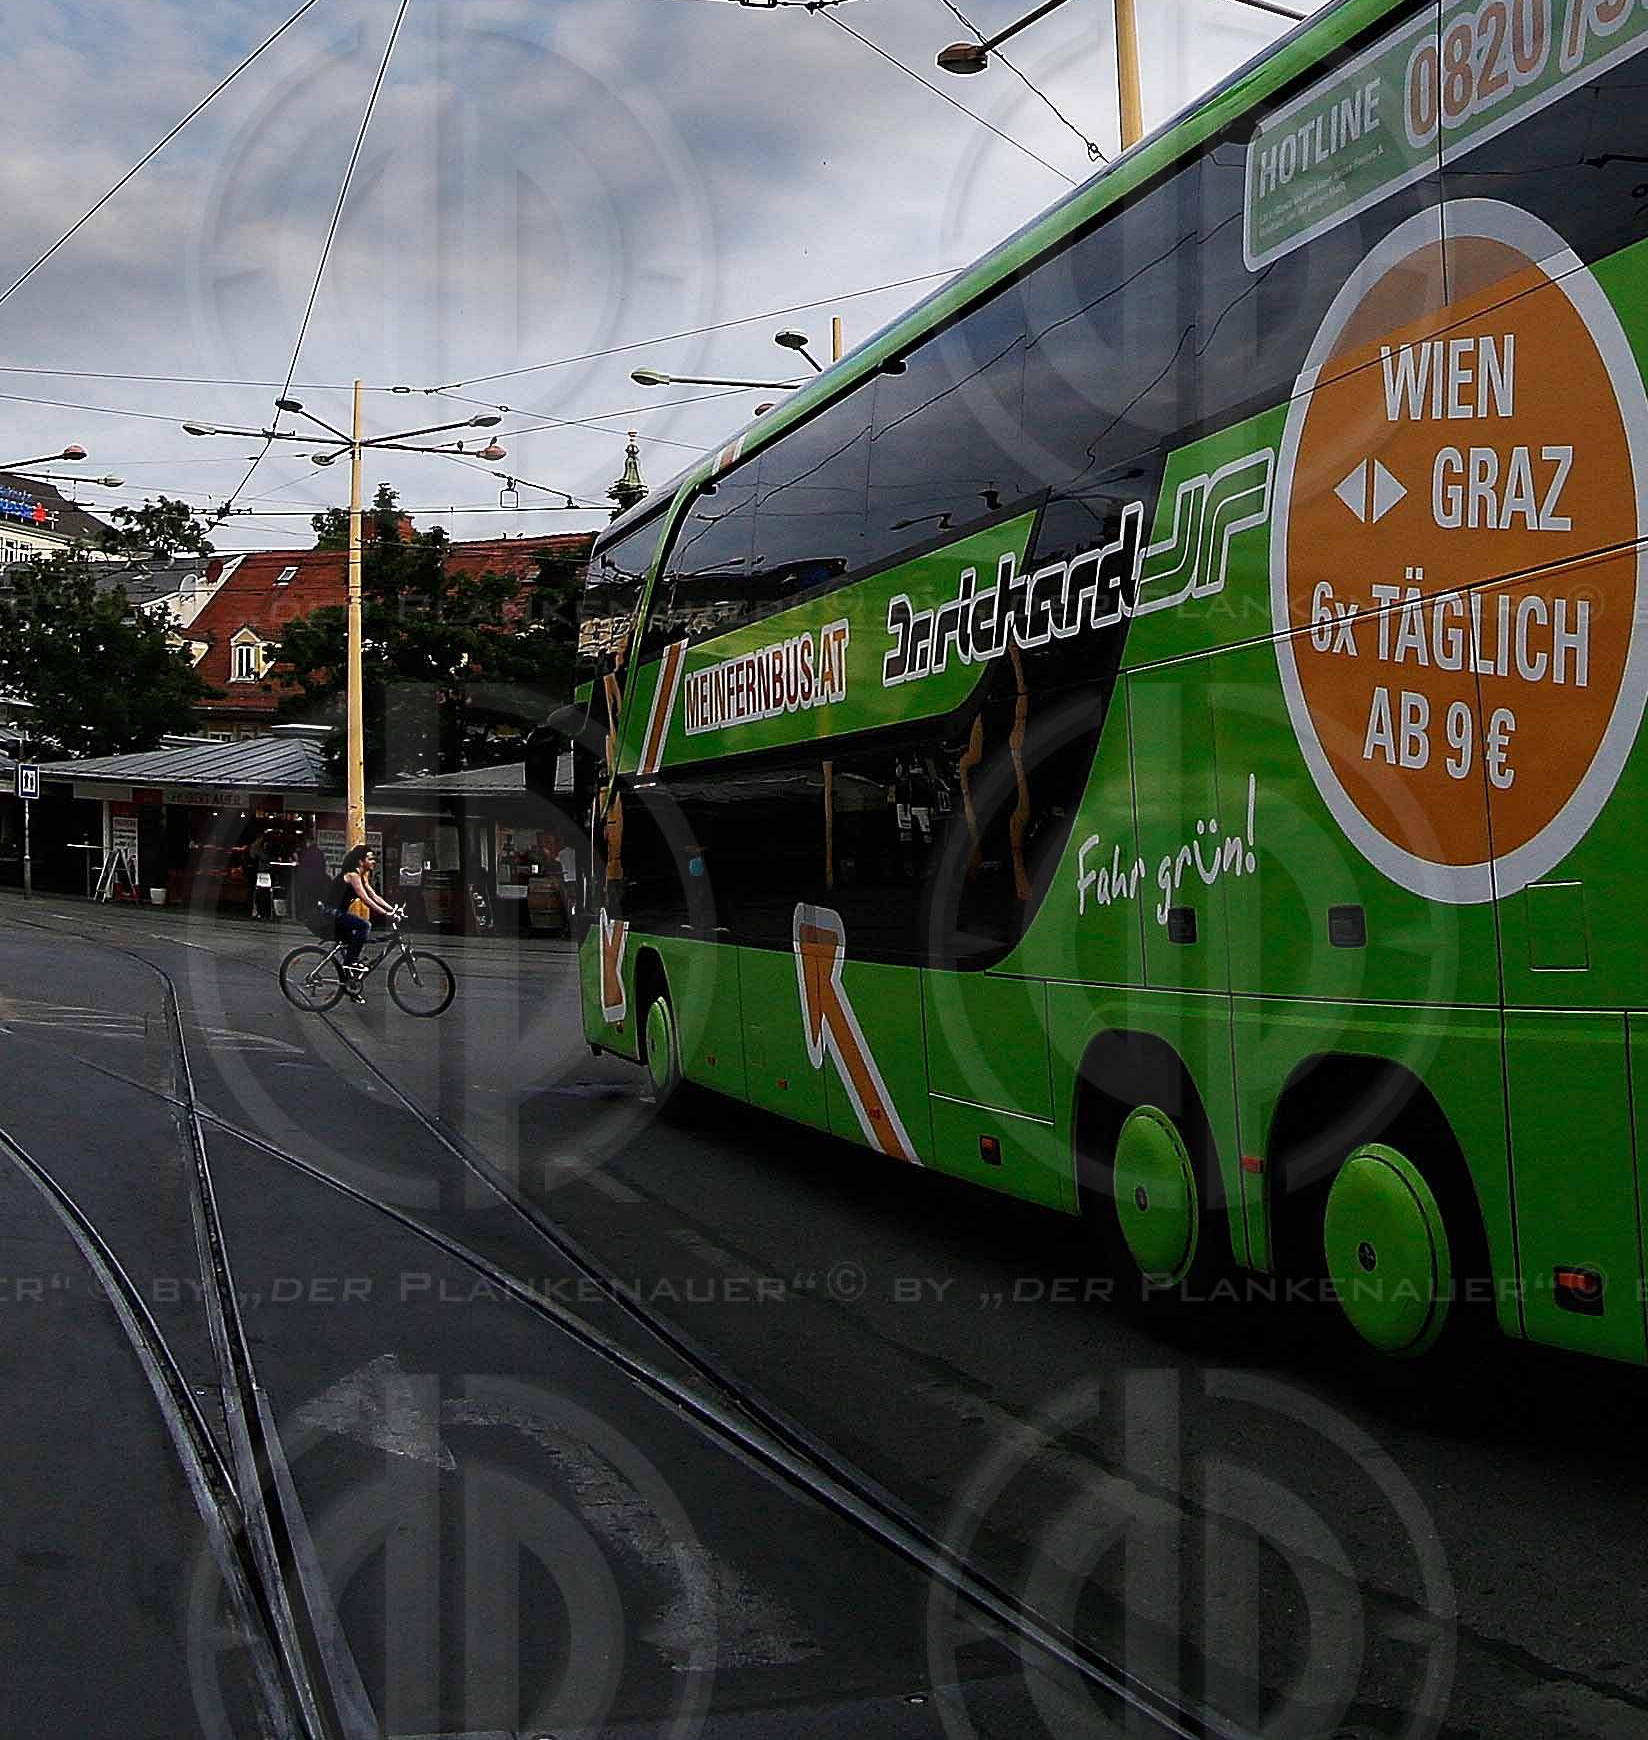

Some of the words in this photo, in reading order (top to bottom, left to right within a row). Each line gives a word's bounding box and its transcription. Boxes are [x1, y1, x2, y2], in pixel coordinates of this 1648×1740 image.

[1259, 76, 1381, 199] HOTLINE
[1380, 334, 1515, 422] WIEN
[1430, 444, 1576, 533] GRAZ
[1309, 579, 1358, 660] 6x
[1371, 566, 1590, 689] TÄGLICH
[1361, 685, 1432, 772] AB
[1445, 700, 1473, 781] 9
[1484, 706, 1517, 791] €
[1076, 833, 1146, 916] Fahr
[1156, 772, 1256, 925] grün!
